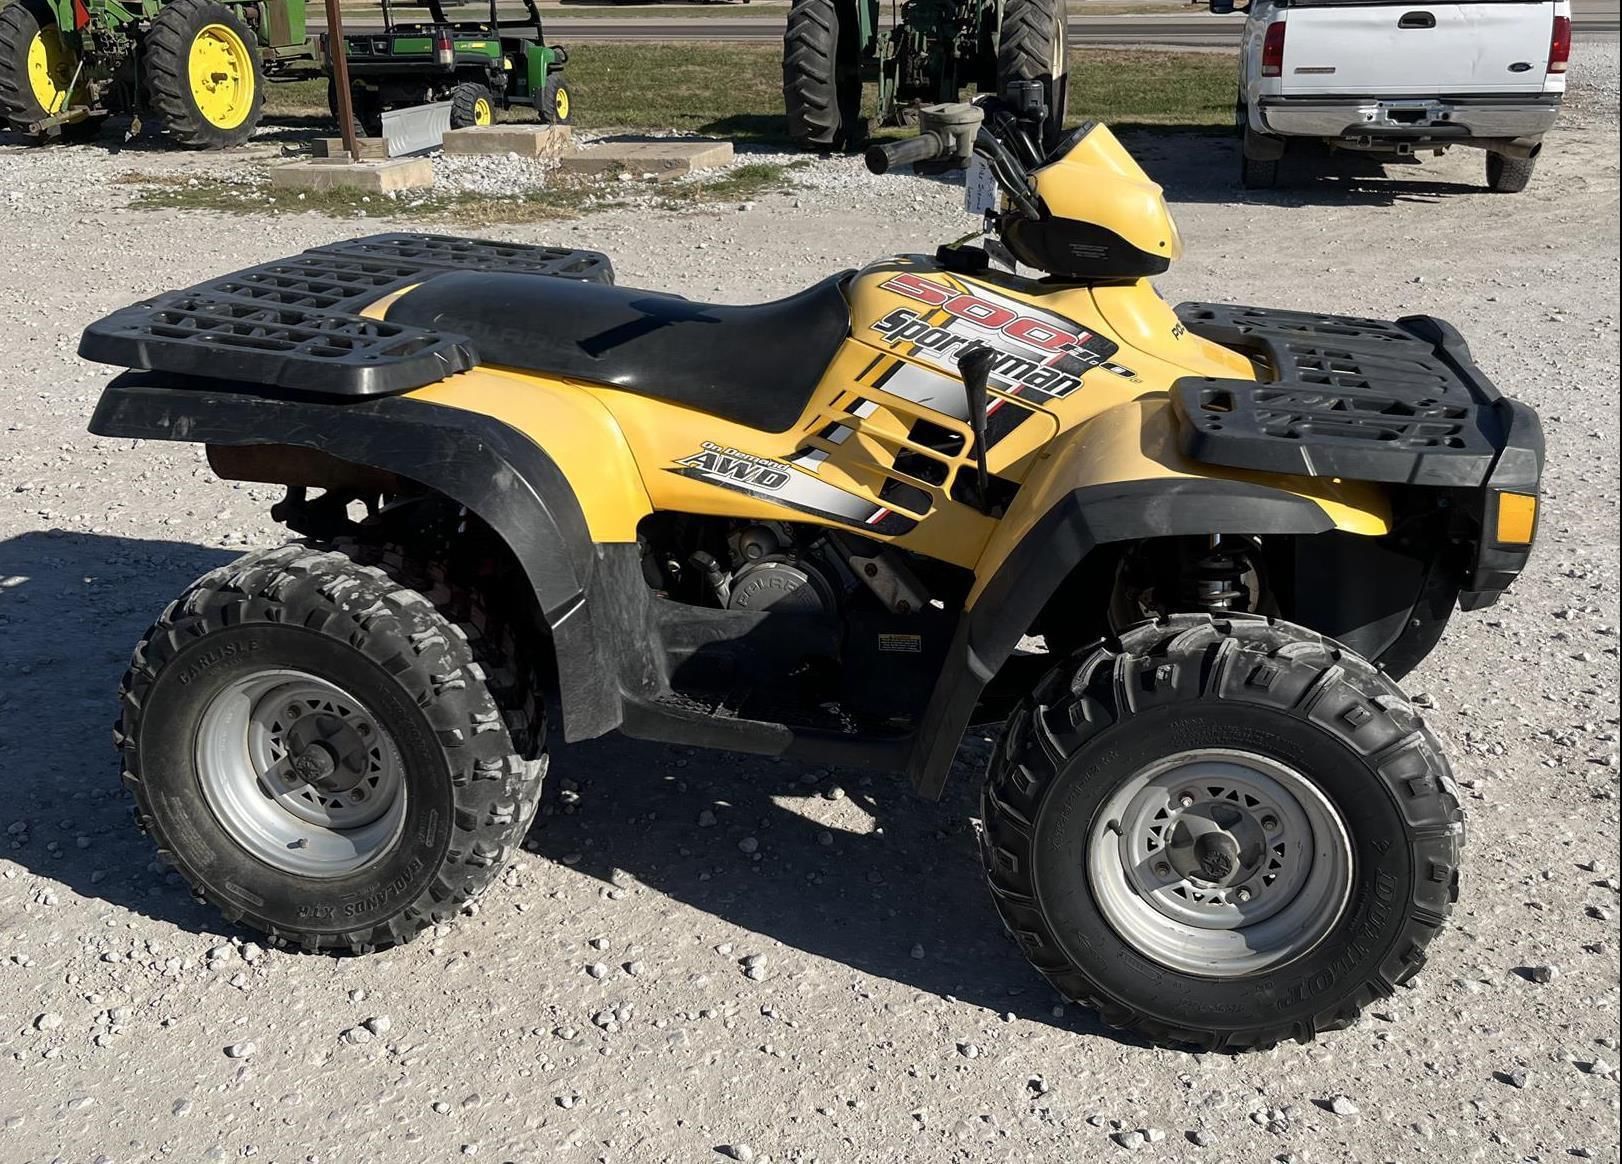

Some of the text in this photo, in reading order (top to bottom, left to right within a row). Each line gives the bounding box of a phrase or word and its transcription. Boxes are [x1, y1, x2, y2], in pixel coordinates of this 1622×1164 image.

[879, 272, 1079, 353] 500
[869, 307, 1084, 400] Sportman
[672, 448, 791, 491] AWD
[701, 441, 792, 472] On Demand
[176, 639, 260, 687] CARLISLE
